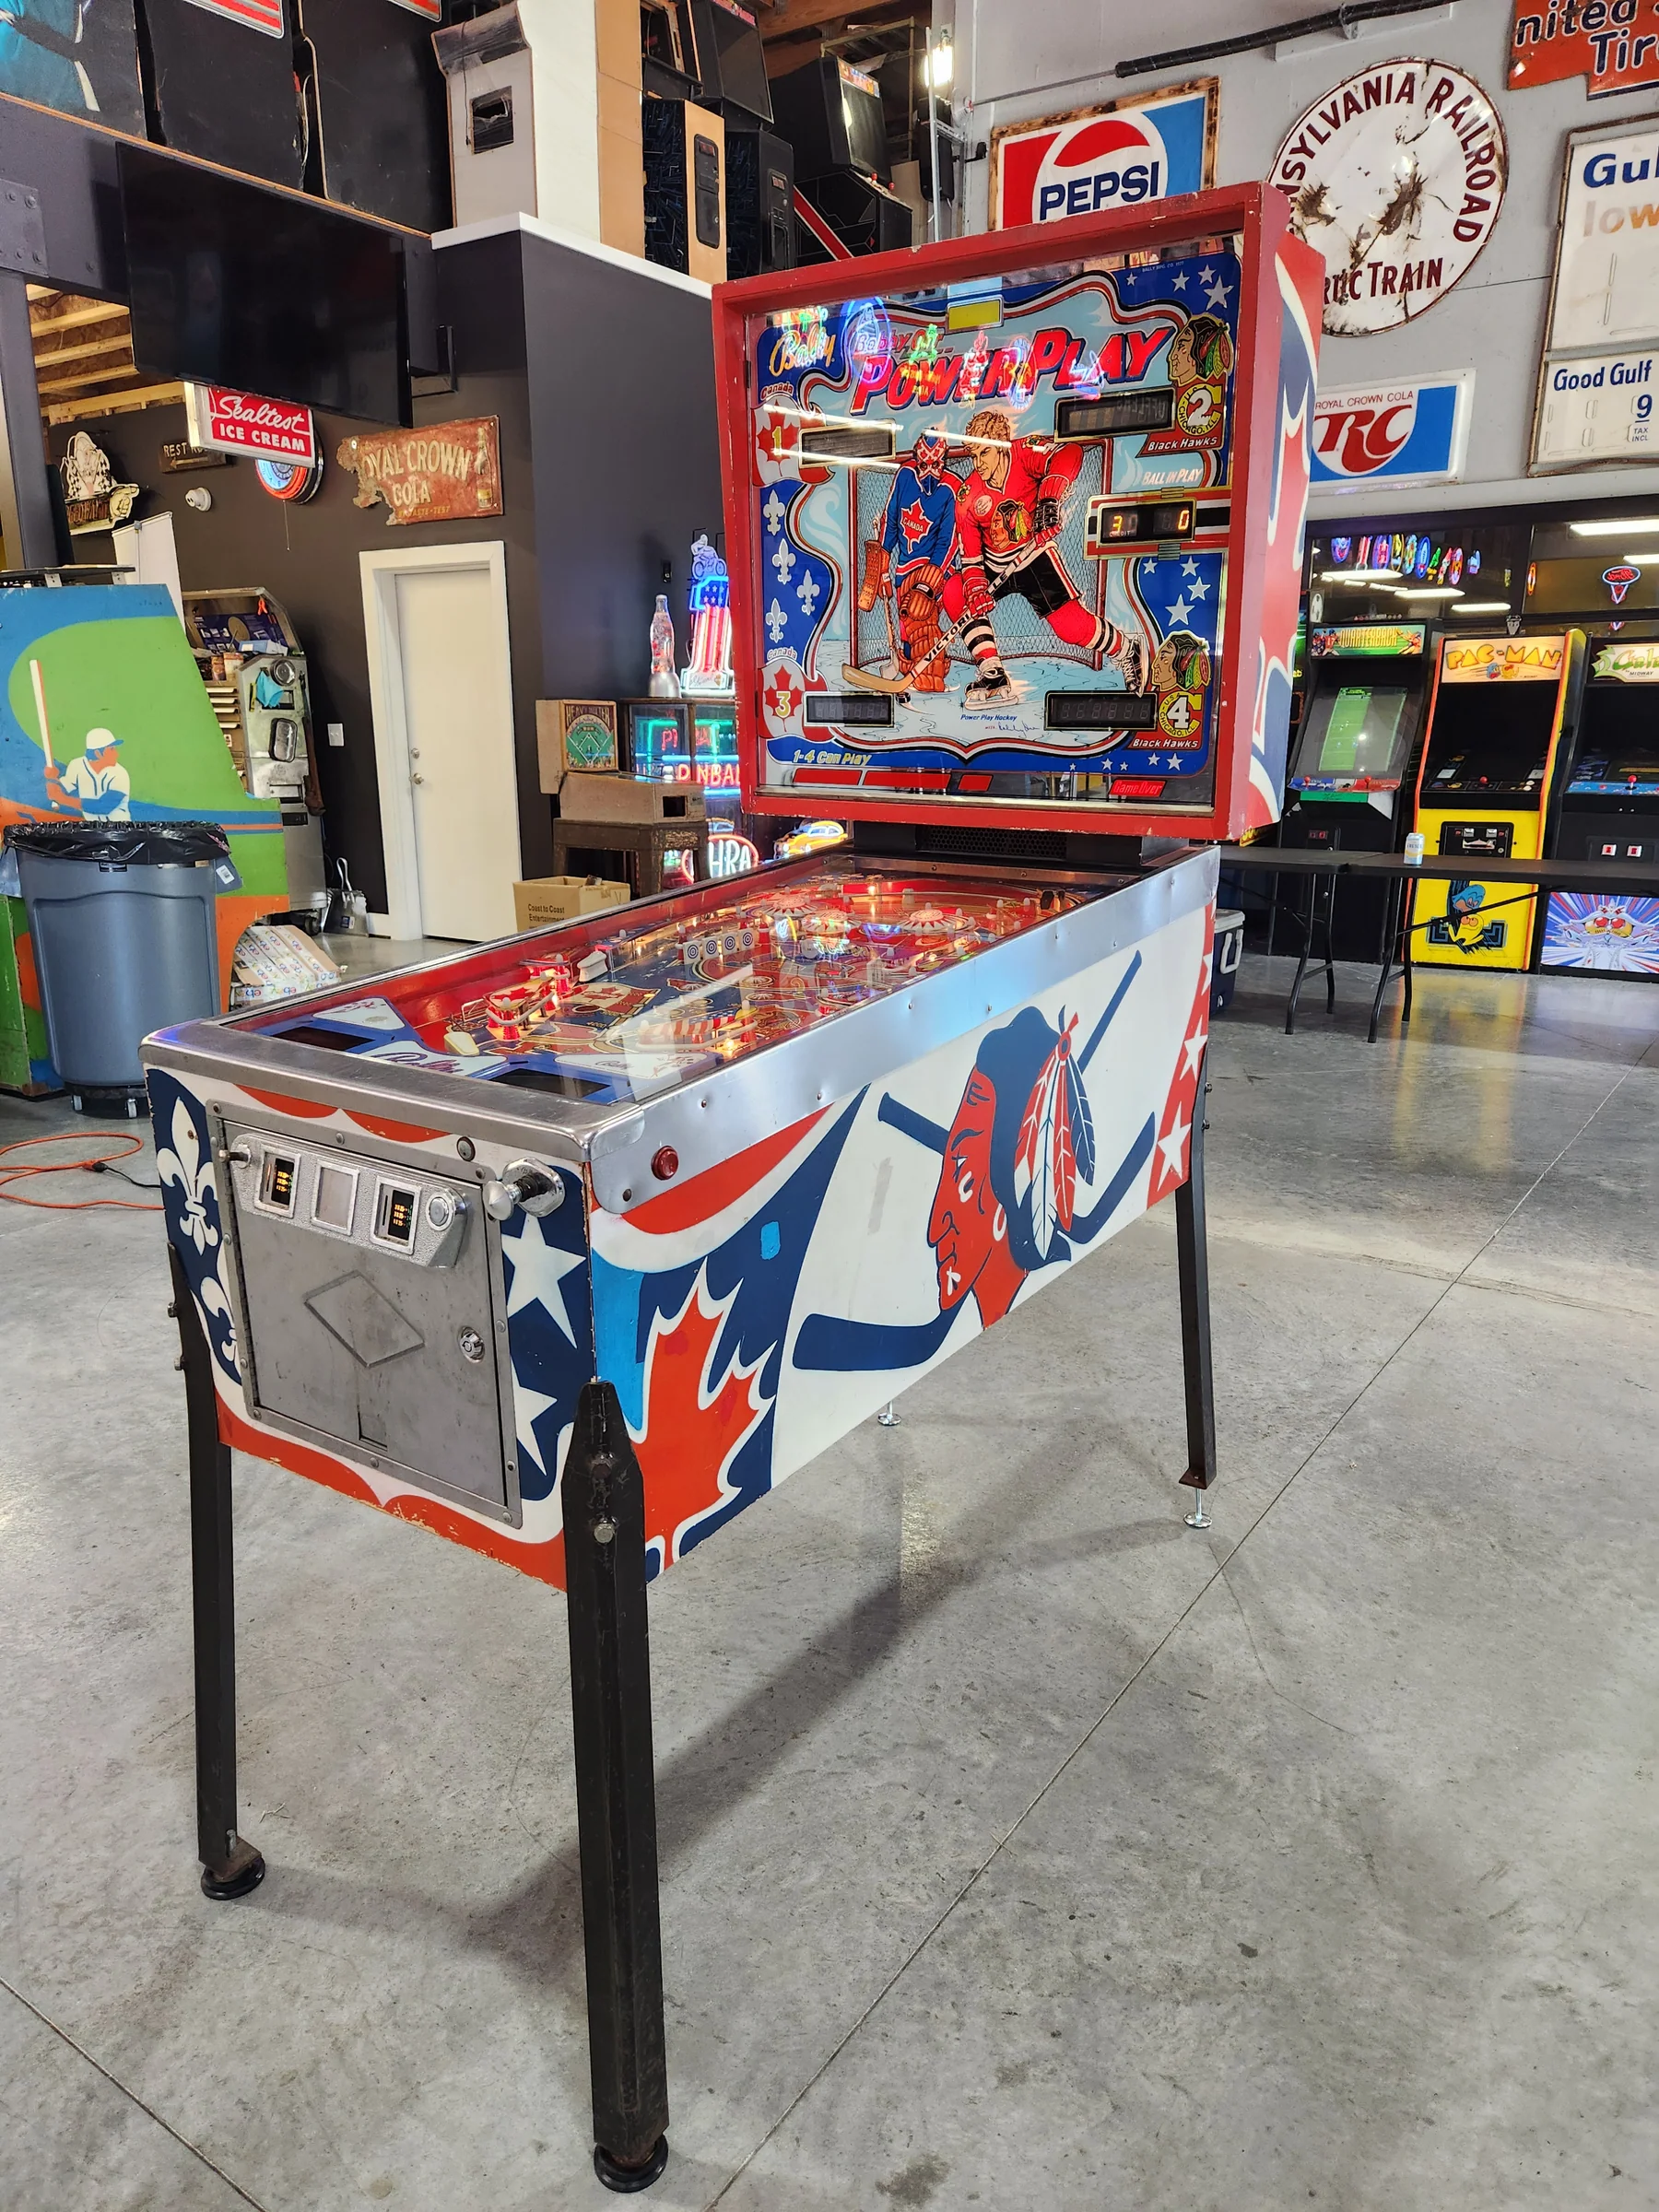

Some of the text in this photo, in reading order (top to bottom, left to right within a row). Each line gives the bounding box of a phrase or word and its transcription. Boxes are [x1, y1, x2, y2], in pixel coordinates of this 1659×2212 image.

[1588, 29, 1659, 76] Tir
[1276, 72, 1497, 243] NSYLVANIA RAILROAD
[1583, 145, 1659, 188] Gu
[1040, 161, 1159, 220] PEPSI
[1368, 257, 1443, 297] TRAIN
[1554, 359, 1653, 391] Good Gulf
[760, 381, 794, 401] Canada
[1315, 391, 1414, 410] ROYAL CROWN COLA
[211, 394, 310, 434] Sealtest
[1188, 389, 1212, 427] 2
[1637, 394, 1653, 423] 9
[163, 442, 187, 457] REST
[219, 423, 305, 452] ICE CREAM
[1147, 436, 1218, 452] Black Hawks
[1314, 405, 1412, 472] RC
[362, 440, 472, 481] OYAL CROWN
[1142, 468, 1203, 486] BALL IN PLAY
[393, 480, 431, 507] COLA
[902, 516, 924, 532] CANADA
[1339, 628, 1398, 648] QUARTERBACK
[767, 646, 798, 662] Canada
[1446, 644, 1562, 670] PAC-MAN
[775, 691, 792, 718] 3
[981, 713, 994, 722] Play
[995, 713, 1018, 722] Hockey
[1167, 697, 1189, 729] 4
[1132, 738, 1198, 748] Black Hawks
[793, 749, 872, 767] 1-4 Can Play
[1113, 782, 1163, 794] Game Over
[706, 839, 752, 878] HRA
[528, 903, 542, 913] Coast
[549, 905, 565, 914] Coast
